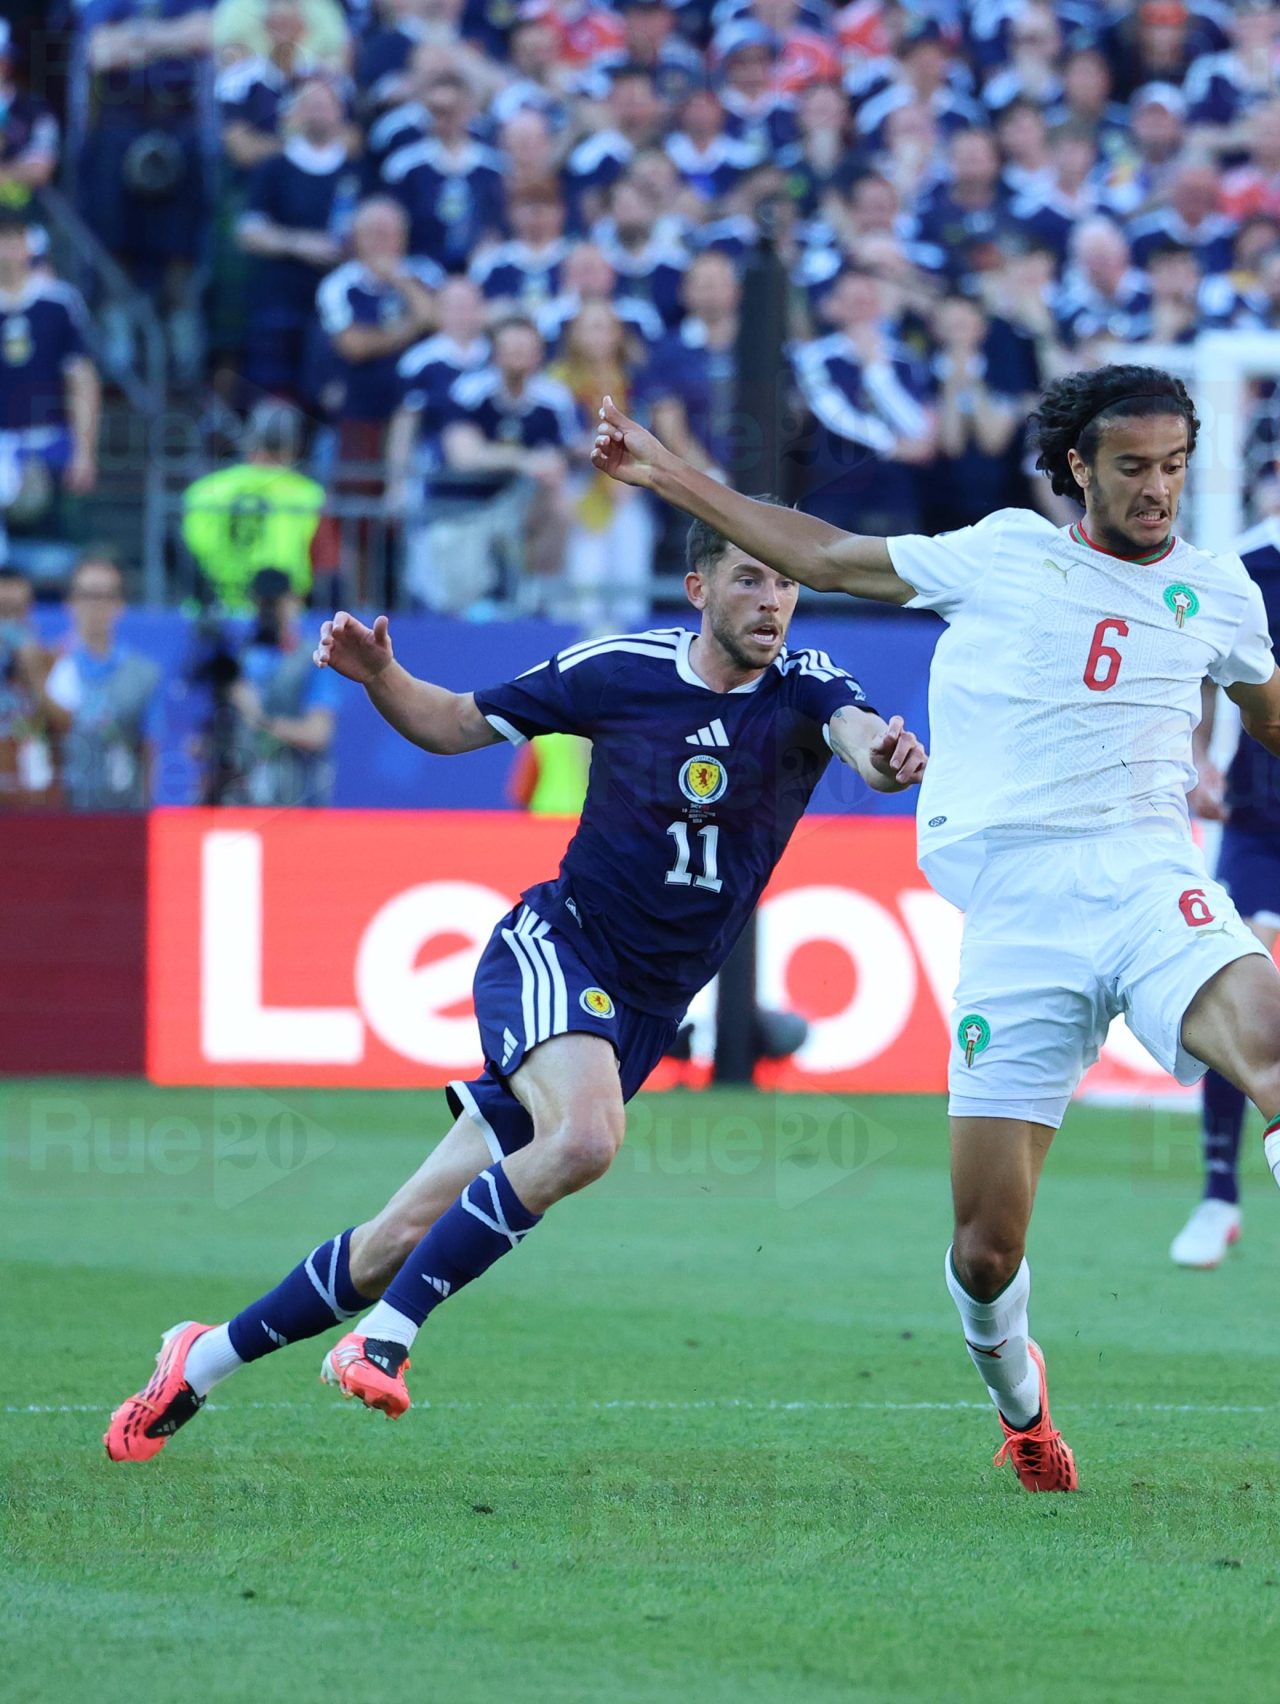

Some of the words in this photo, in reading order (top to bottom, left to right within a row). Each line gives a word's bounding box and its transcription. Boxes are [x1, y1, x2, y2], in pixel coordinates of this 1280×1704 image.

[1083, 618, 1129, 691] 6
[664, 820, 723, 894] 11
[1178, 888, 1216, 927] 6
